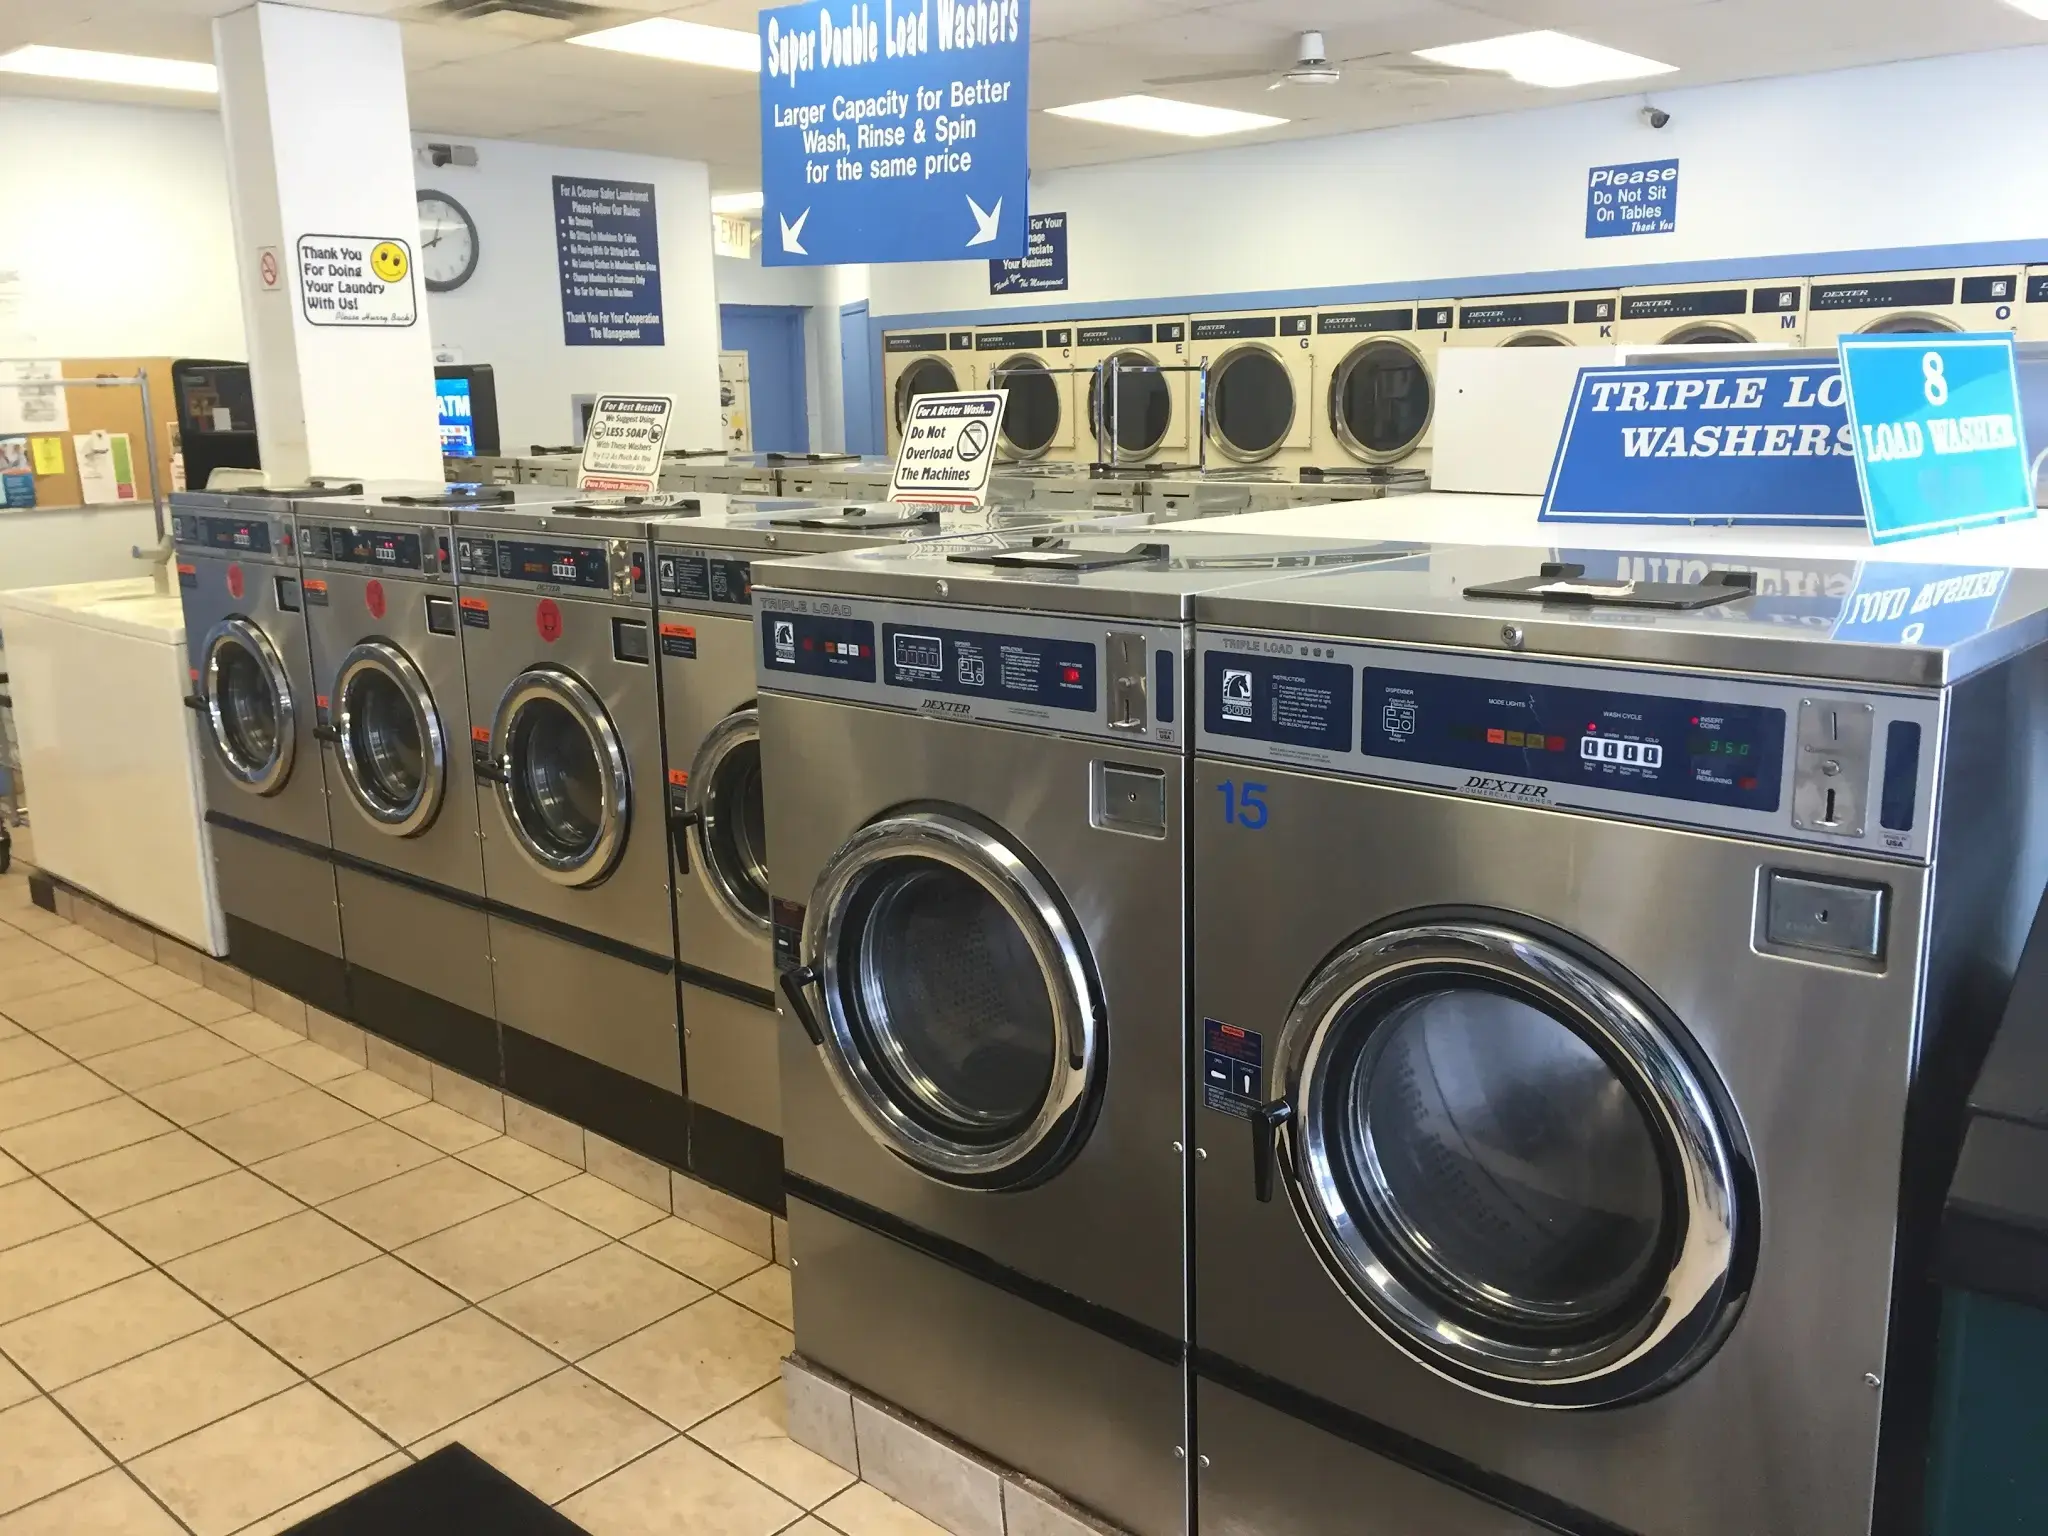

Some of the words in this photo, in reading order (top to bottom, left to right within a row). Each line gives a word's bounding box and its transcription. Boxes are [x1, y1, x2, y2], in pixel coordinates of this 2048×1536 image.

[768, 17, 816, 88] Super
[820, 3, 878, 68] Double
[885, 0, 928, 59] Load
[937, 0, 1019, 51] Washers
[774, 104, 825, 130] Larger
[832, 91, 909, 125] Capacity
[916, 86, 943, 111] for
[951, 80, 1011, 107] Better
[803, 128, 850, 154] Wash,
[857, 123, 905, 149] Rinse
[914, 118, 926, 143] &
[935, 114, 976, 145] Spin
[806, 162, 829, 183] for
[836, 158, 862, 181] the
[870, 158, 917, 179] same
[925, 150, 972, 179] price
[1590, 167, 1677, 187] Please
[1594, 191, 1612, 205] Do
[1618, 187, 1642, 203] Not
[1647, 185, 1667, 201] Sit
[1596, 207, 1615, 222] On
[1620, 204, 1662, 220] Tables
[1031, 218, 1043, 230] For
[1044, 217, 1063, 229] Your
[1631, 221, 1656, 232] Thank
[1659, 219, 1674, 231] You
[721, 219, 745, 246] EXIT
[302, 245, 338, 260] Thank
[340, 248, 362, 261] You
[304, 263, 324, 276] For
[328, 264, 362, 277] Doing
[1003, 259, 1020, 270] Your
[1021, 256, 1053, 268] Business
[305, 280, 334, 293] Your
[338, 281, 385, 294] Laundry
[1822, 289, 1869, 298] DEXTER
[307, 297, 335, 310] With
[338, 297, 358, 310] Us!
[1631, 300, 1672, 308] DEXTER
[566, 311, 586, 323] Thank
[587, 312, 599, 323] You
[599, 312, 609, 323] For
[610, 312, 624, 324] Your
[1468, 310, 1504, 318] DEXTER
[1995, 305, 2011, 320] O
[1781, 315, 1796, 328] M
[589, 327, 601, 338] The
[1600, 325, 1611, 338] K
[1176, 344, 1183, 353] E
[1300, 338, 1309, 349] G
[1062, 349, 1070, 358] C
[1922, 351, 1948, 406] 8
[1591, 376, 1767, 412] TRIPLE
[1783, 375, 1846, 408] LO
[436, 395, 471, 417] ATM
[604, 402, 617, 411] For
[617, 403, 634, 411] Best
[635, 403, 662, 412] Results
[917, 407, 929, 417] For
[929, 407, 938, 416] A
[937, 406, 962, 416] Better
[606, 414, 614, 422] We
[616, 415, 638, 424] Suggest
[606, 427, 624, 437] LESS
[626, 427, 648, 438] SOAP
[911, 426, 924, 439] Do
[926, 425, 946, 439] Not
[1862, 421, 1924, 462] LOAD
[1927, 414, 2017, 455] WASHER
[596, 441, 610, 449] With
[611, 441, 627, 450] These
[628, 442, 652, 451] Washers
[1622, 423, 1856, 458] WASHERS
[906, 446, 954, 460] Overload
[901, 467, 919, 480] The
[921, 466, 970, 480] Machines
[760, 598, 807, 612] TRIPLE
[813, 602, 852, 616] LOAD
[1223, 638, 1260, 651] TRIPLE
[1263, 642, 1293, 655] LOAD
[921, 699, 971, 714] DEXTER
[1505, 700, 1526, 708] LIGHTS
[1699, 722, 1721, 730] COINS
[1700, 716, 1724, 724] INSERT
[1696, 768, 1712, 776] TIME
[1465, 776, 1548, 797] DEXTER
[1696, 775, 1733, 785] REMAINING
[1216, 778, 1269, 830] 15
[1517, 795, 1553, 805] WASHER
[1886, 838, 1904, 848] USA
